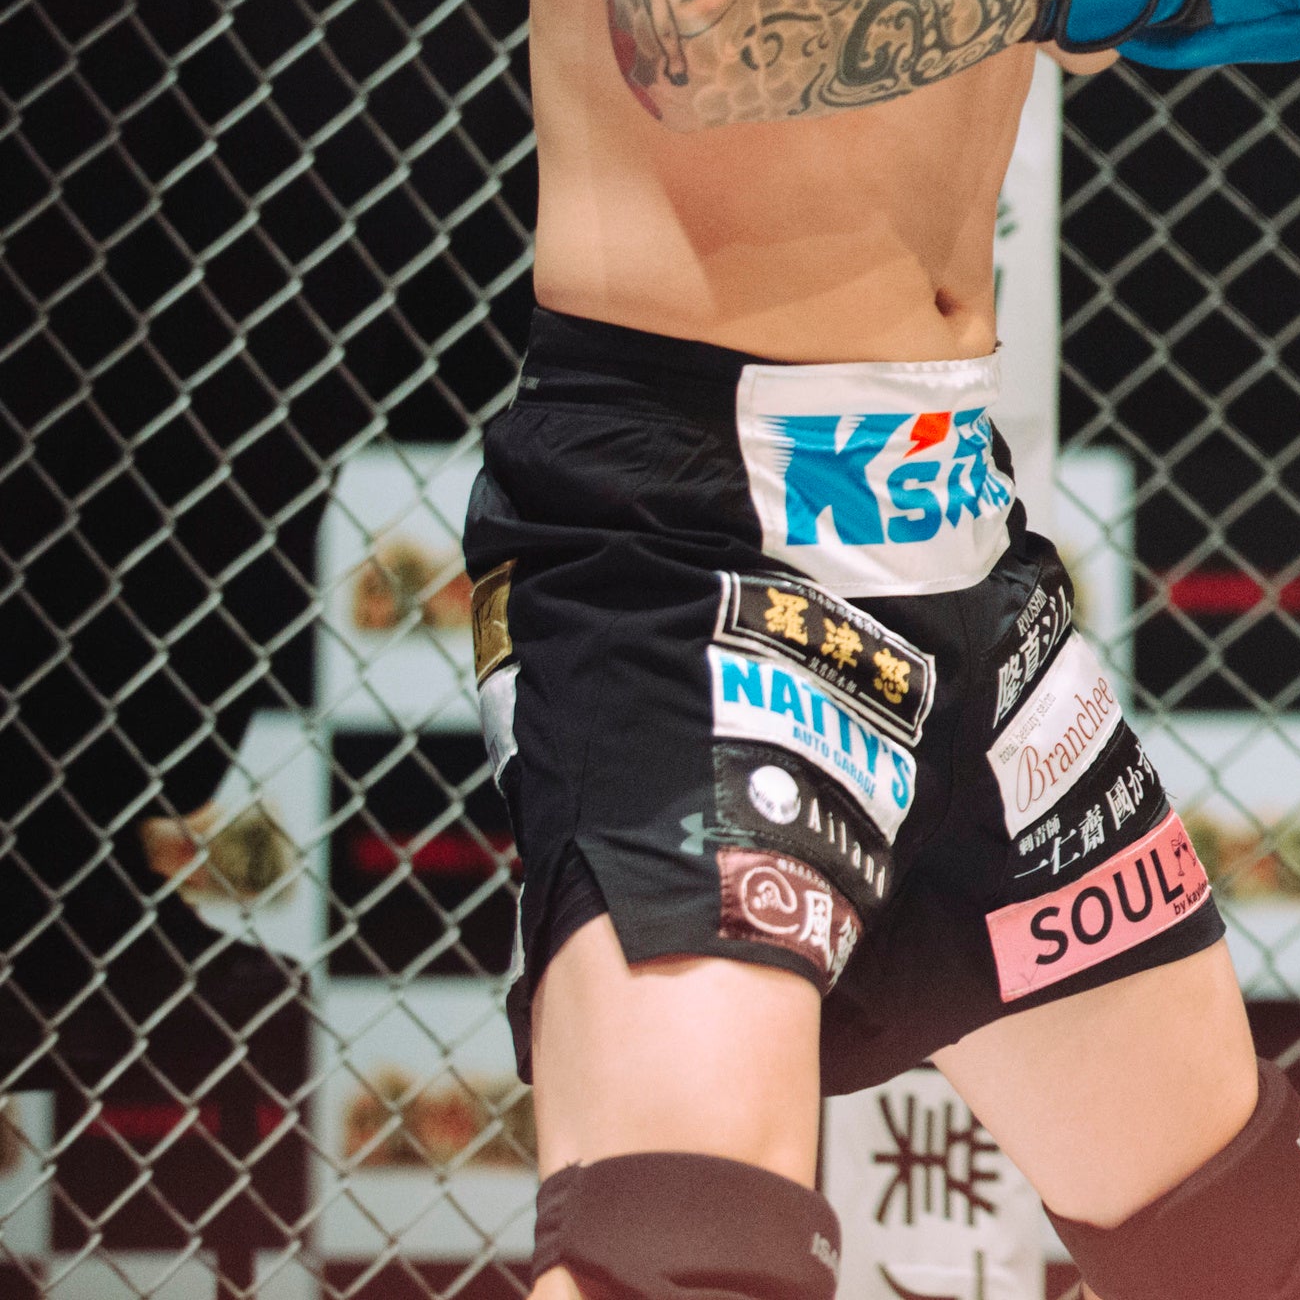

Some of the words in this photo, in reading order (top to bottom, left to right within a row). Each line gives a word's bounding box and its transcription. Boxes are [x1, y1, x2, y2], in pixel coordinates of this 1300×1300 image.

[1016, 584, 1048, 636] RYUSHIN
[720, 653, 911, 810] NATTY'S
[792, 725, 830, 759] AUTO
[833, 751, 877, 800] GARAGE
[1015, 676, 1115, 813] Branchee
[1030, 848, 1185, 966] SOUL
[1172, 898, 1188, 916] by
